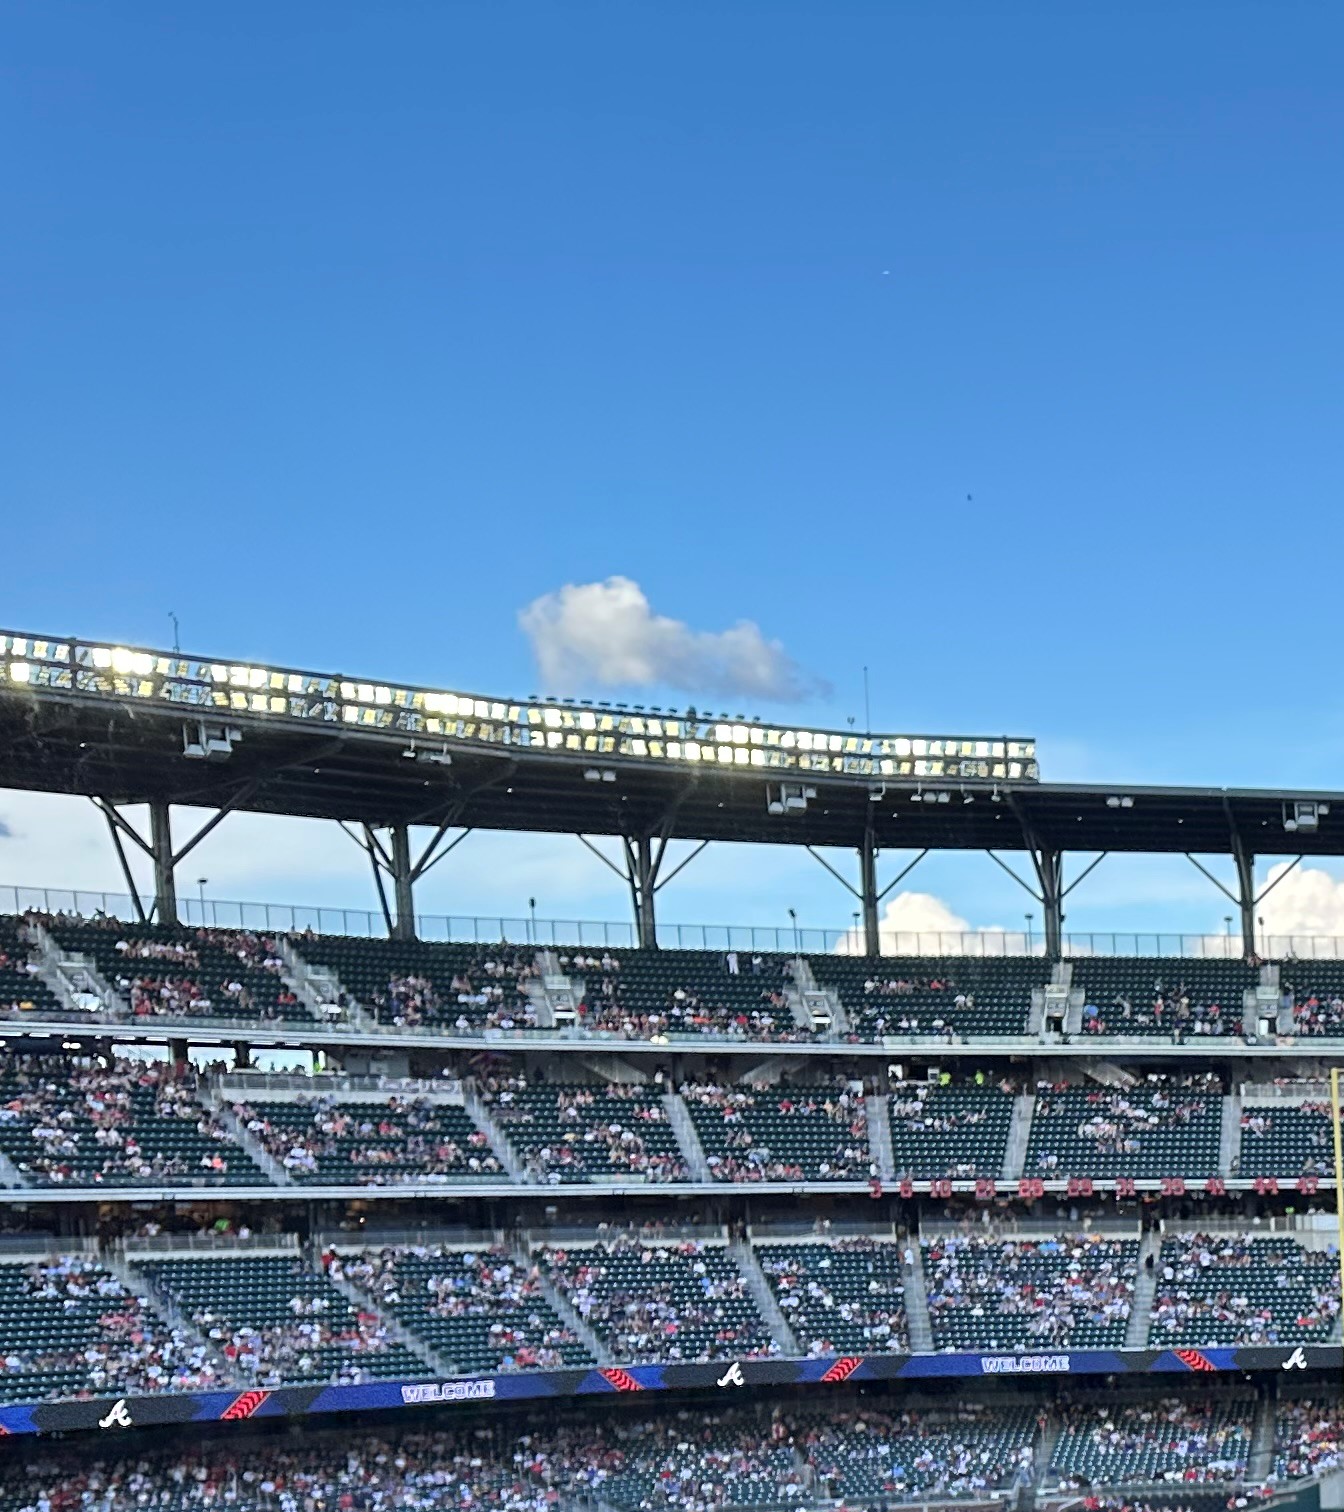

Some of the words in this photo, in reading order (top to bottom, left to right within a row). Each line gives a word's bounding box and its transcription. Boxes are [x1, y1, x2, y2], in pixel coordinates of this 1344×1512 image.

[931, 1178, 952, 1197] 10
[1205, 1177, 1226, 1196] 41
[1252, 1177, 1278, 1196] 44
[1296, 1177, 1319, 1196] 47
[981, 1355, 1070, 1373] WELCOME
[401, 1380, 496, 1403] WELCOME
